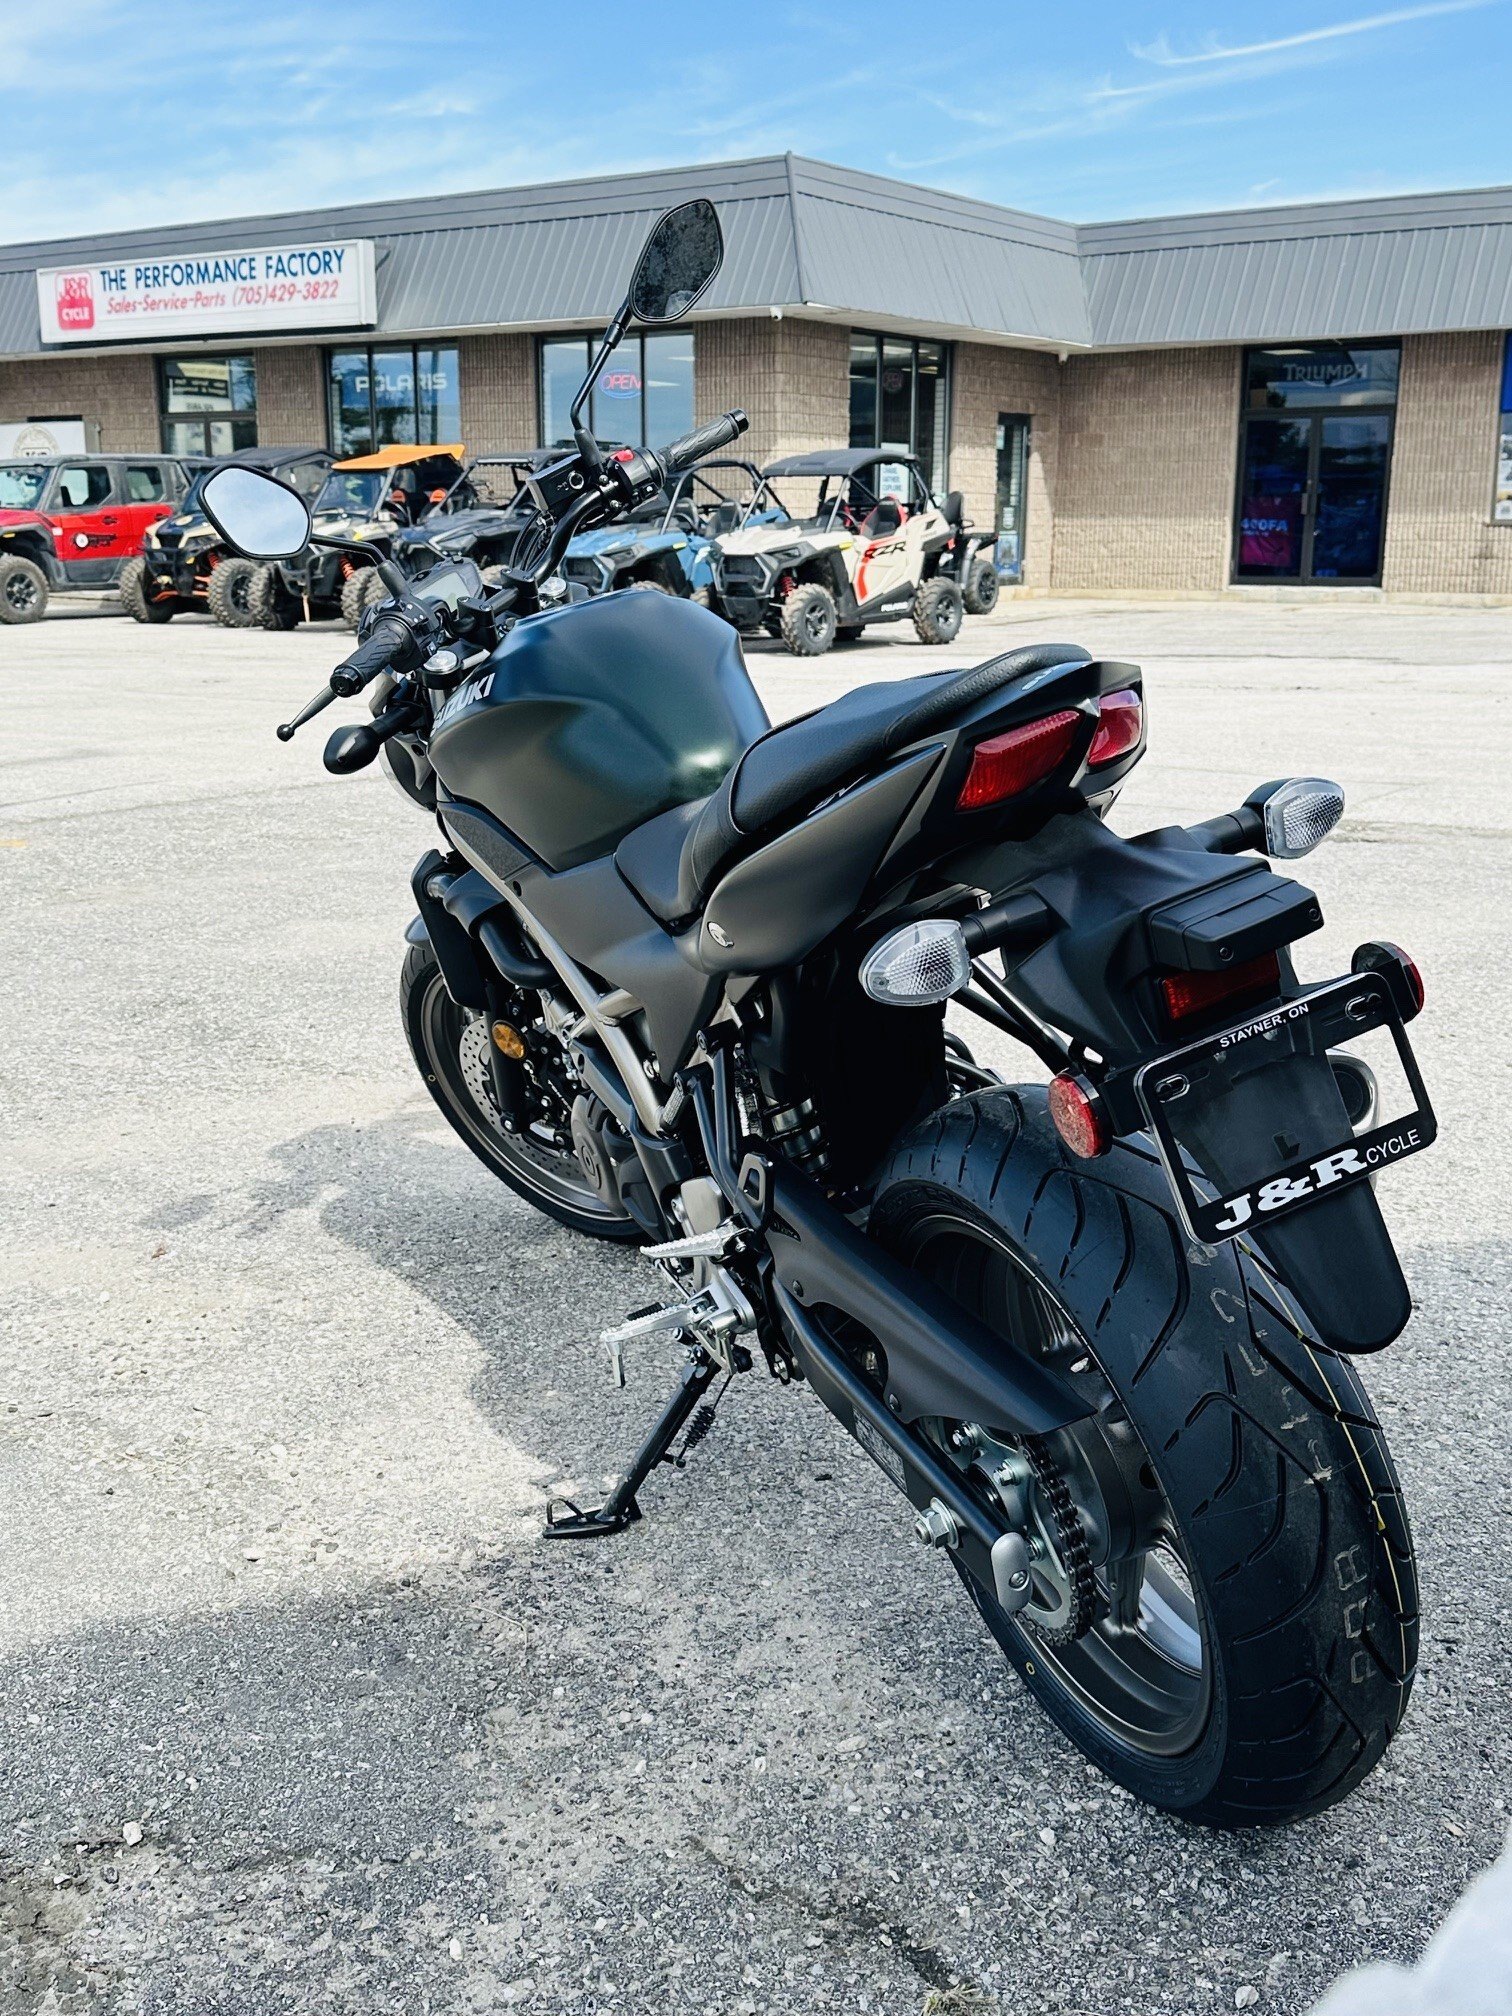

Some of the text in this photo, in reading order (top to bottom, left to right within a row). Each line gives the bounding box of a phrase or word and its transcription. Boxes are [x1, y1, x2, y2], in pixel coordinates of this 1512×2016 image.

[100, 248, 345, 291] THE PERFORMANCE FACTORY
[58, 277, 89, 300] J&R
[61, 306, 90, 321] CYCLE
[1283, 363, 1368, 381] TRIUMPH
[355, 373, 448, 392] POLARIS
[601, 374, 642, 390] OPEN
[864, 541, 907, 559] RZR
[1219, 1003, 1309, 1048] STAYNER, ON
[1215, 1128, 1421, 1231] J&R CYCLE
